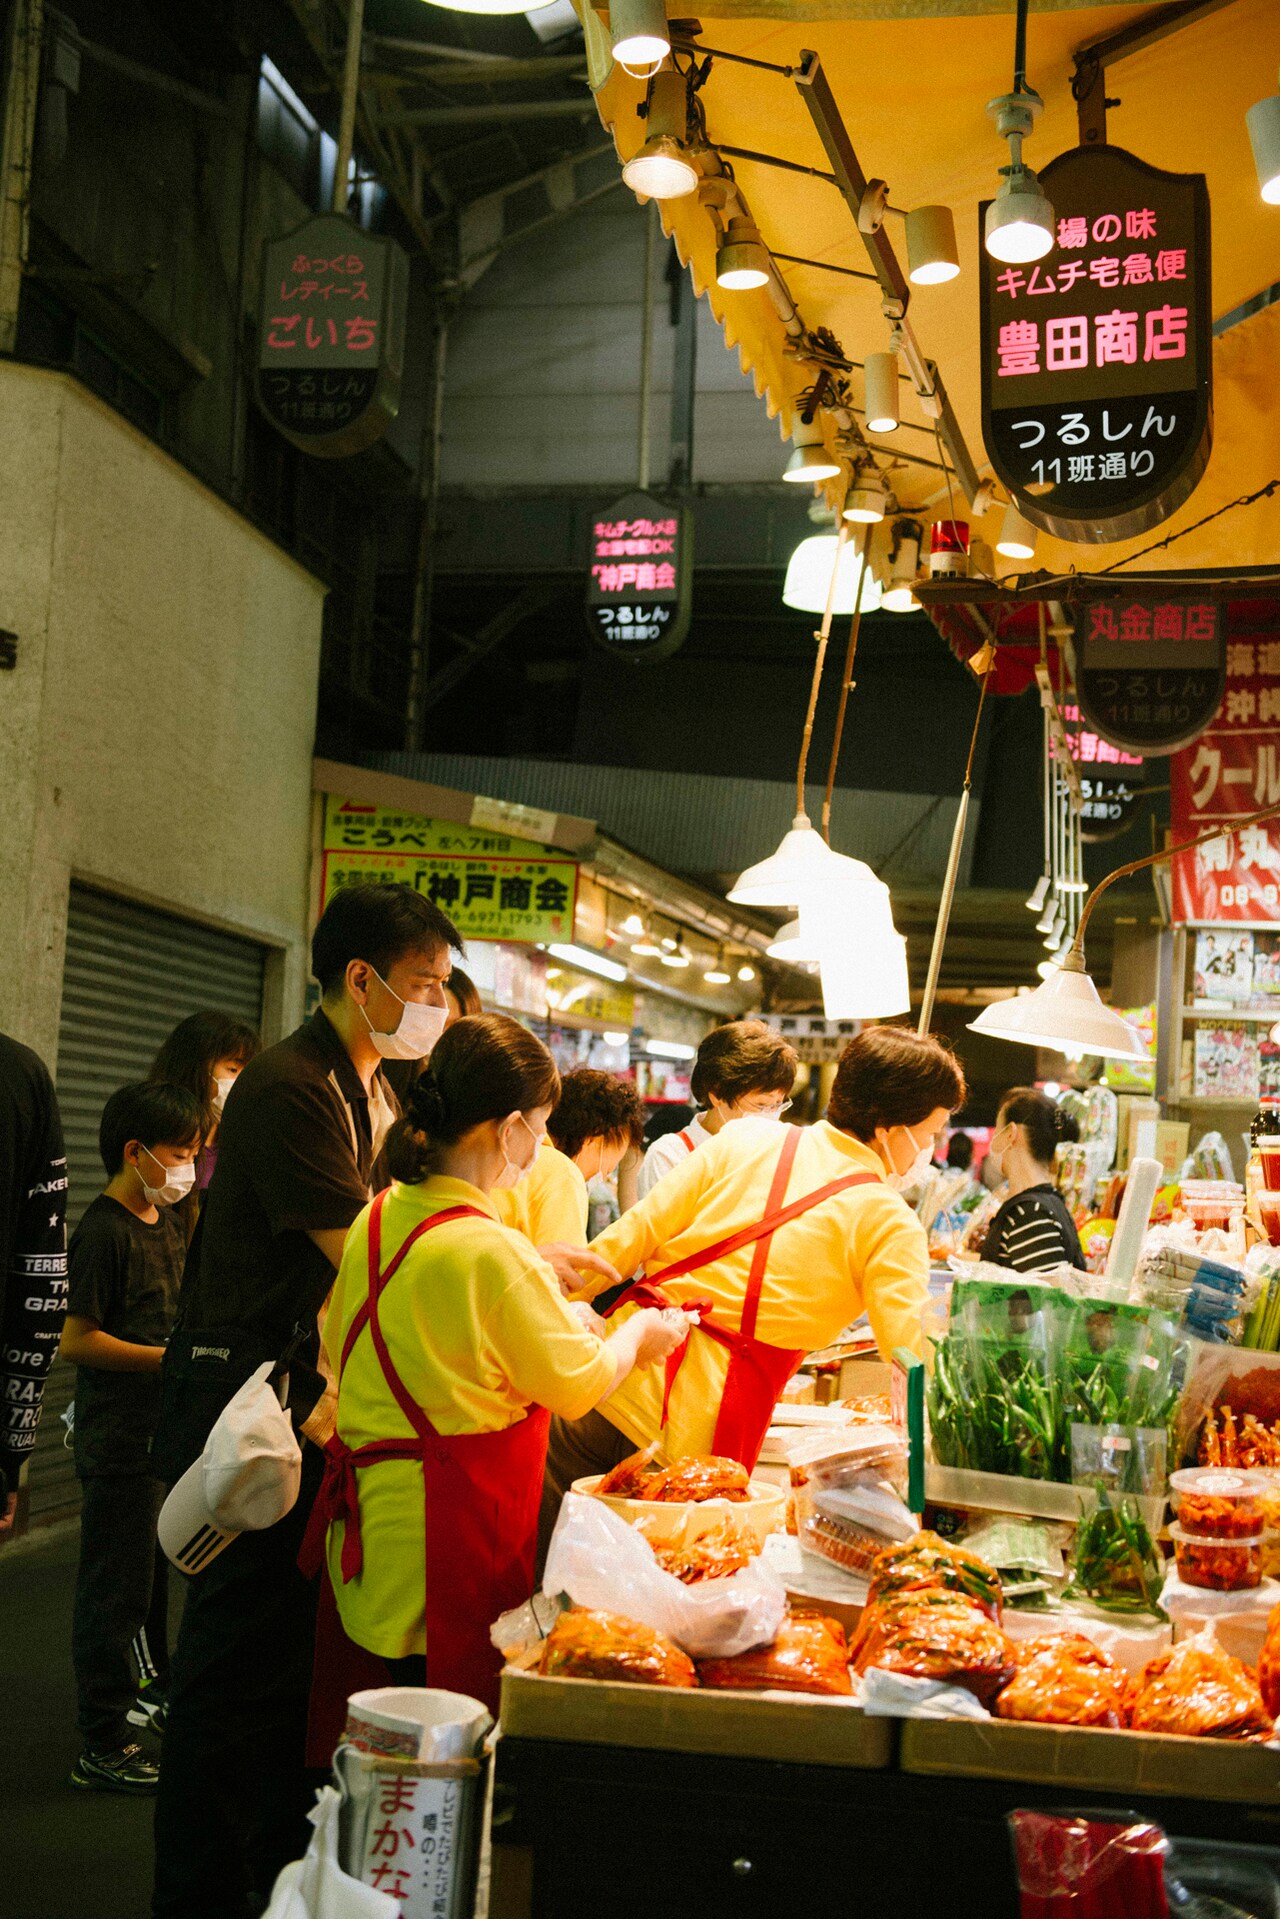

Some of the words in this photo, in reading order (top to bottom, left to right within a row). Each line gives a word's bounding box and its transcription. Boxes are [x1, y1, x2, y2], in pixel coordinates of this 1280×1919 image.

[291, 255, 366, 274] ふっくら
[996, 249, 1188, 299] キムチ宅急便
[279, 280, 369, 301] レディース
[266, 314, 379, 349] ごいち
[997, 304, 1188, 377] 豊田商店
[1011, 406, 1176, 449] つるしん
[1031, 450, 1155, 486] 11班通り
[597, 605, 670, 624] つるしん
[1088, 603, 1216, 641] 丸金商店
[342, 829, 427, 847] こうべ
[191, 1345, 230, 1362] THRASHER
[370, 1776, 419, 1919] まかな
